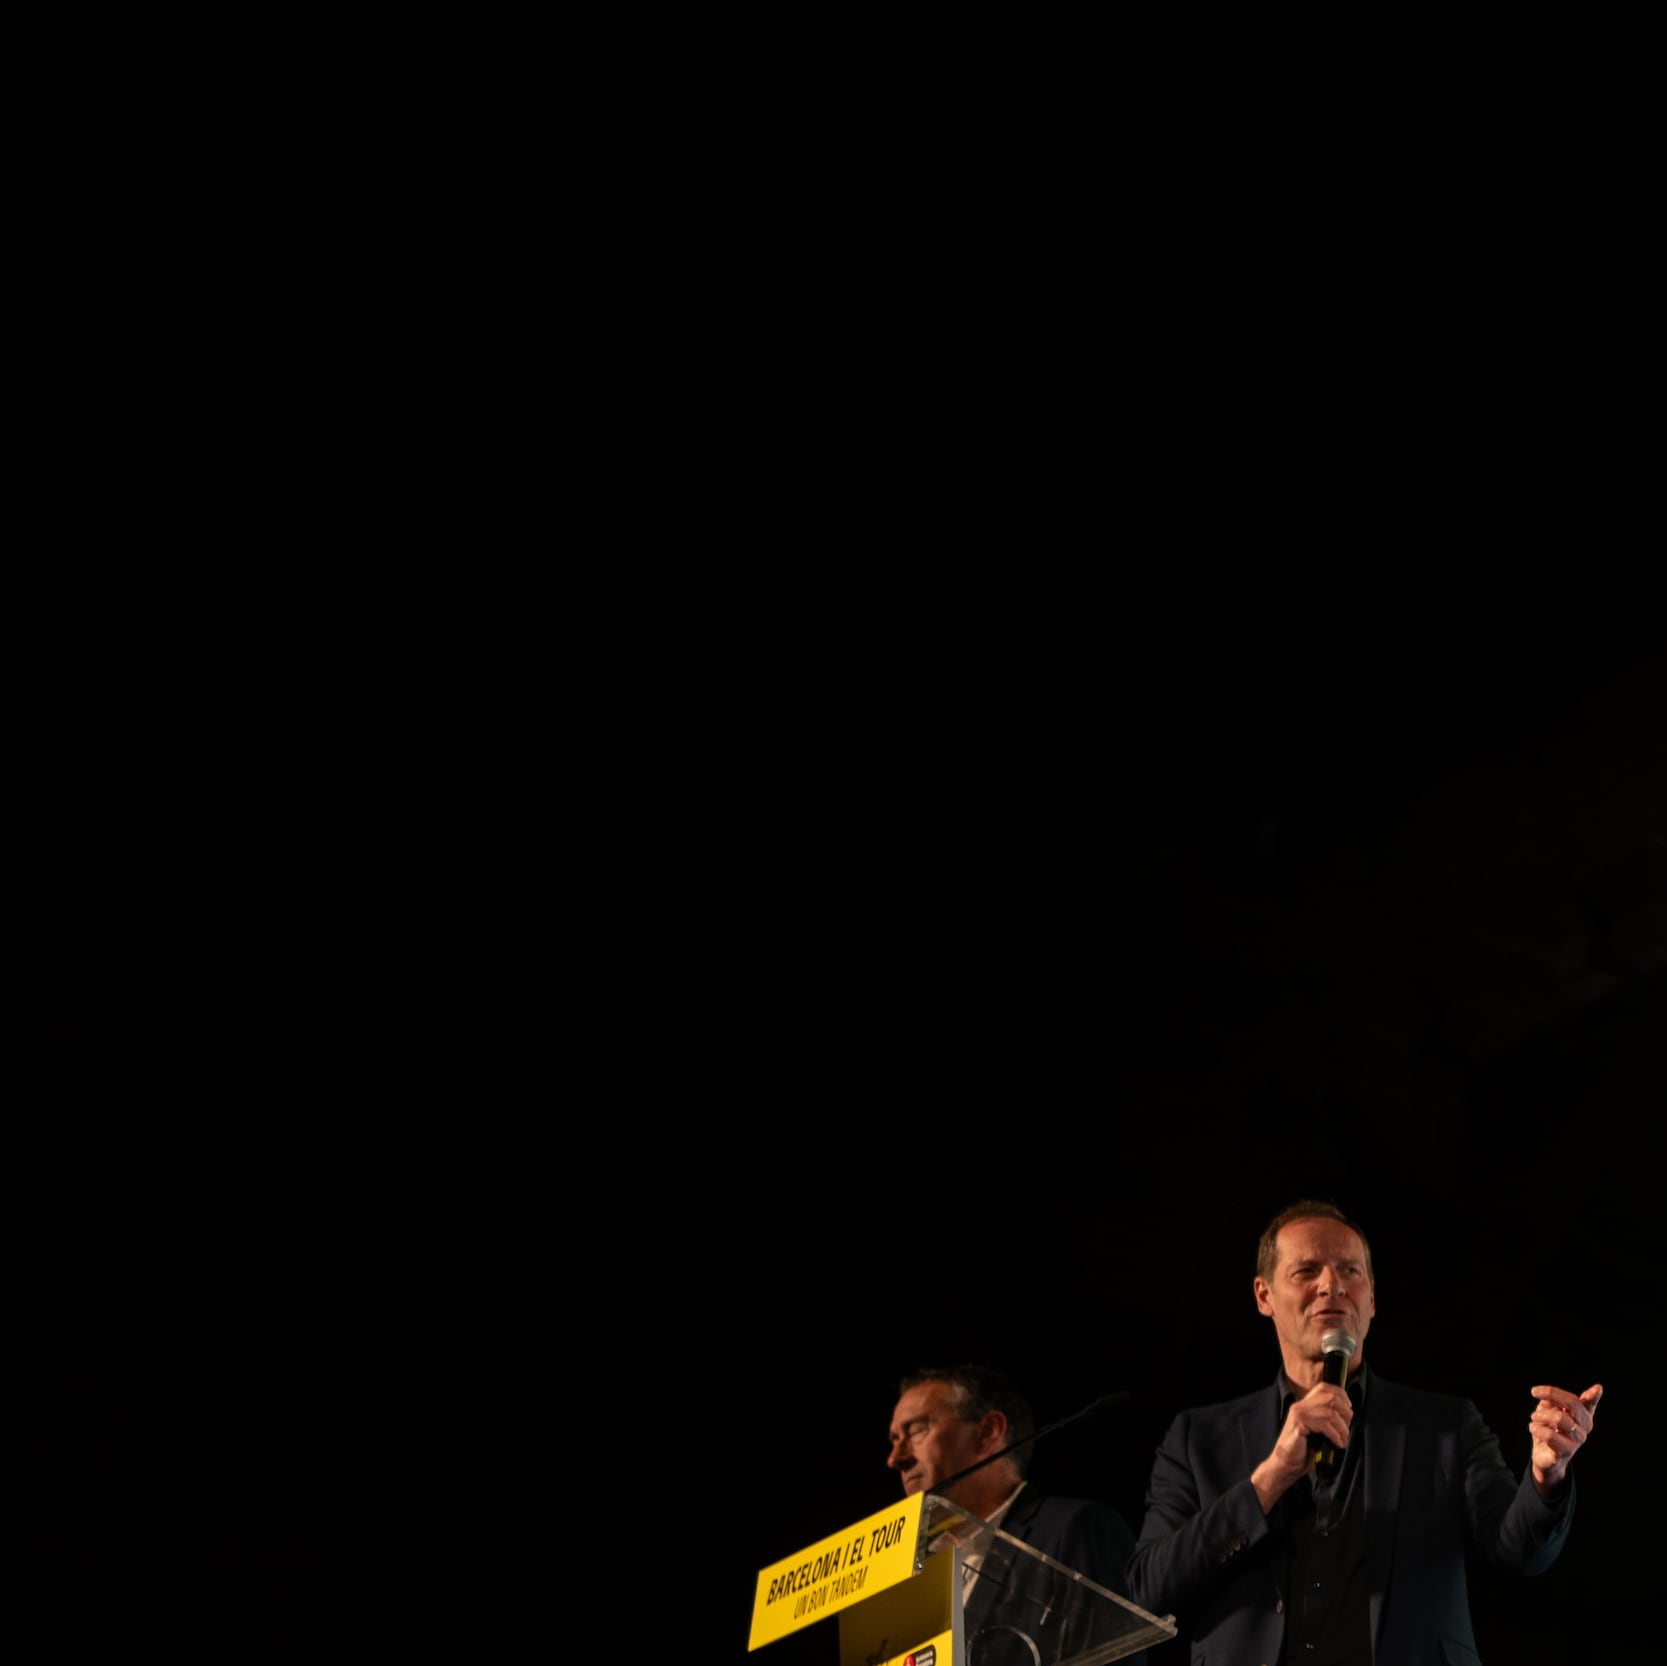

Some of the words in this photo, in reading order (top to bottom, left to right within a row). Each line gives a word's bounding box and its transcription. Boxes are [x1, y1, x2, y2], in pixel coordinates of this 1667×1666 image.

[766, 1547, 841, 1606] BARCELONA
[850, 1536, 865, 1565] EL
[869, 1516, 905, 1557] TOUR
